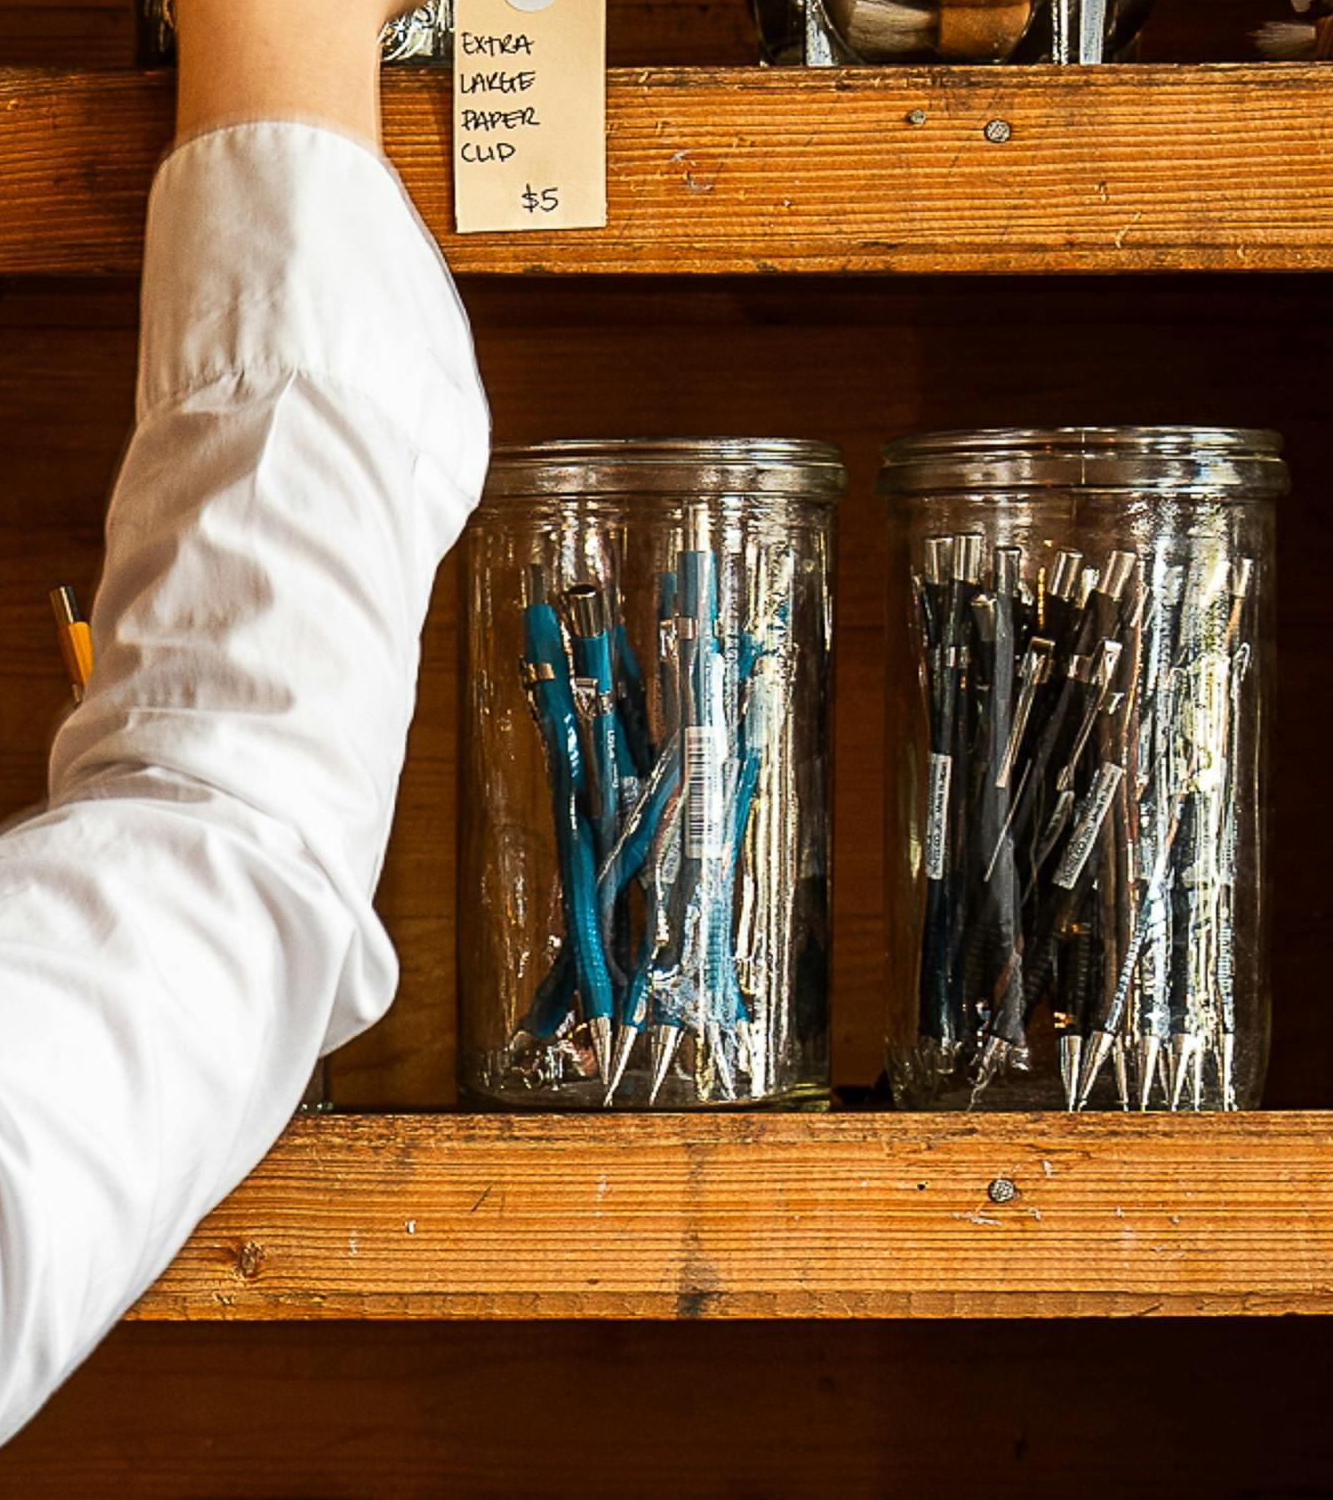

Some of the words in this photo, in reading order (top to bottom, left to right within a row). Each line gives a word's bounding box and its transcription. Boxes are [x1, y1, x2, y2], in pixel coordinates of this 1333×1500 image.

[461, 32, 534, 57] EXTRA
[460, 70, 537, 94] LARGE
[461, 107, 541, 131] PAPER
[521, 183, 559, 212] $5
